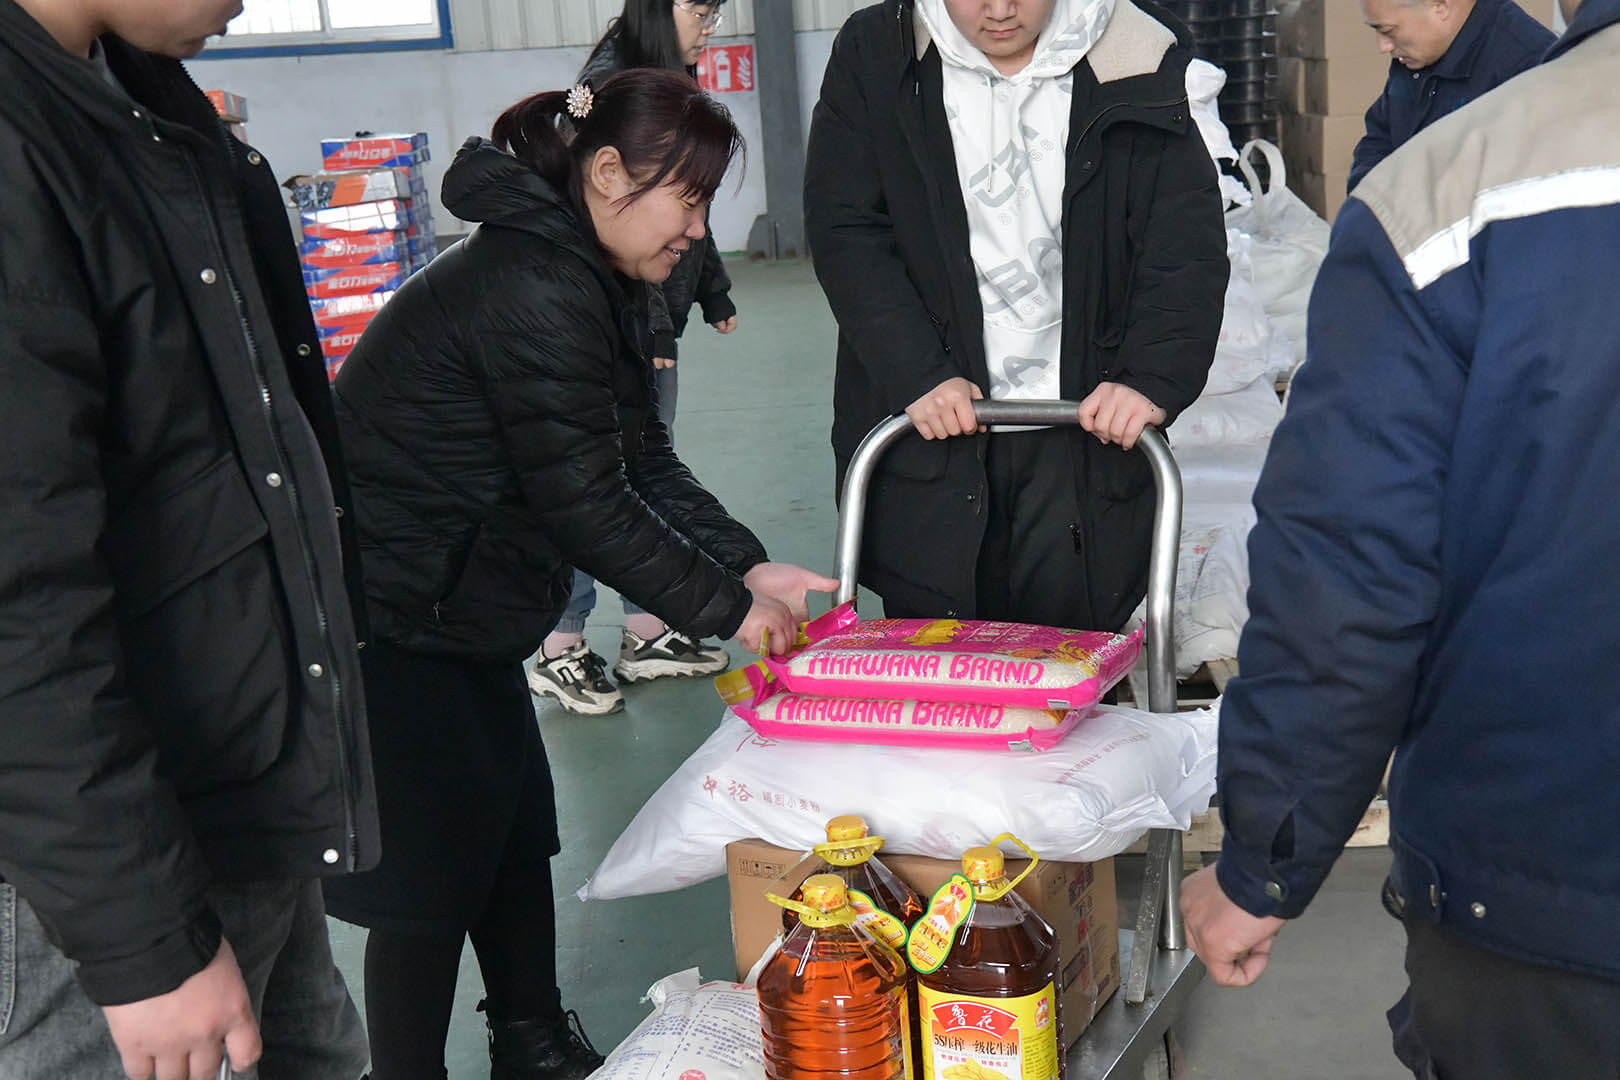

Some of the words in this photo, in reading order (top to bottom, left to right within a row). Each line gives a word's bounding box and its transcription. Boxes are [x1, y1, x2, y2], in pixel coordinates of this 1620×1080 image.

[808, 652, 941, 678] ARAWANA
[949, 654, 1044, 685] BRAND
[775, 695, 904, 724] ARAWANA
[912, 700, 1003, 728] BRAND
[948, 1004, 996, 1030] 鲁花
